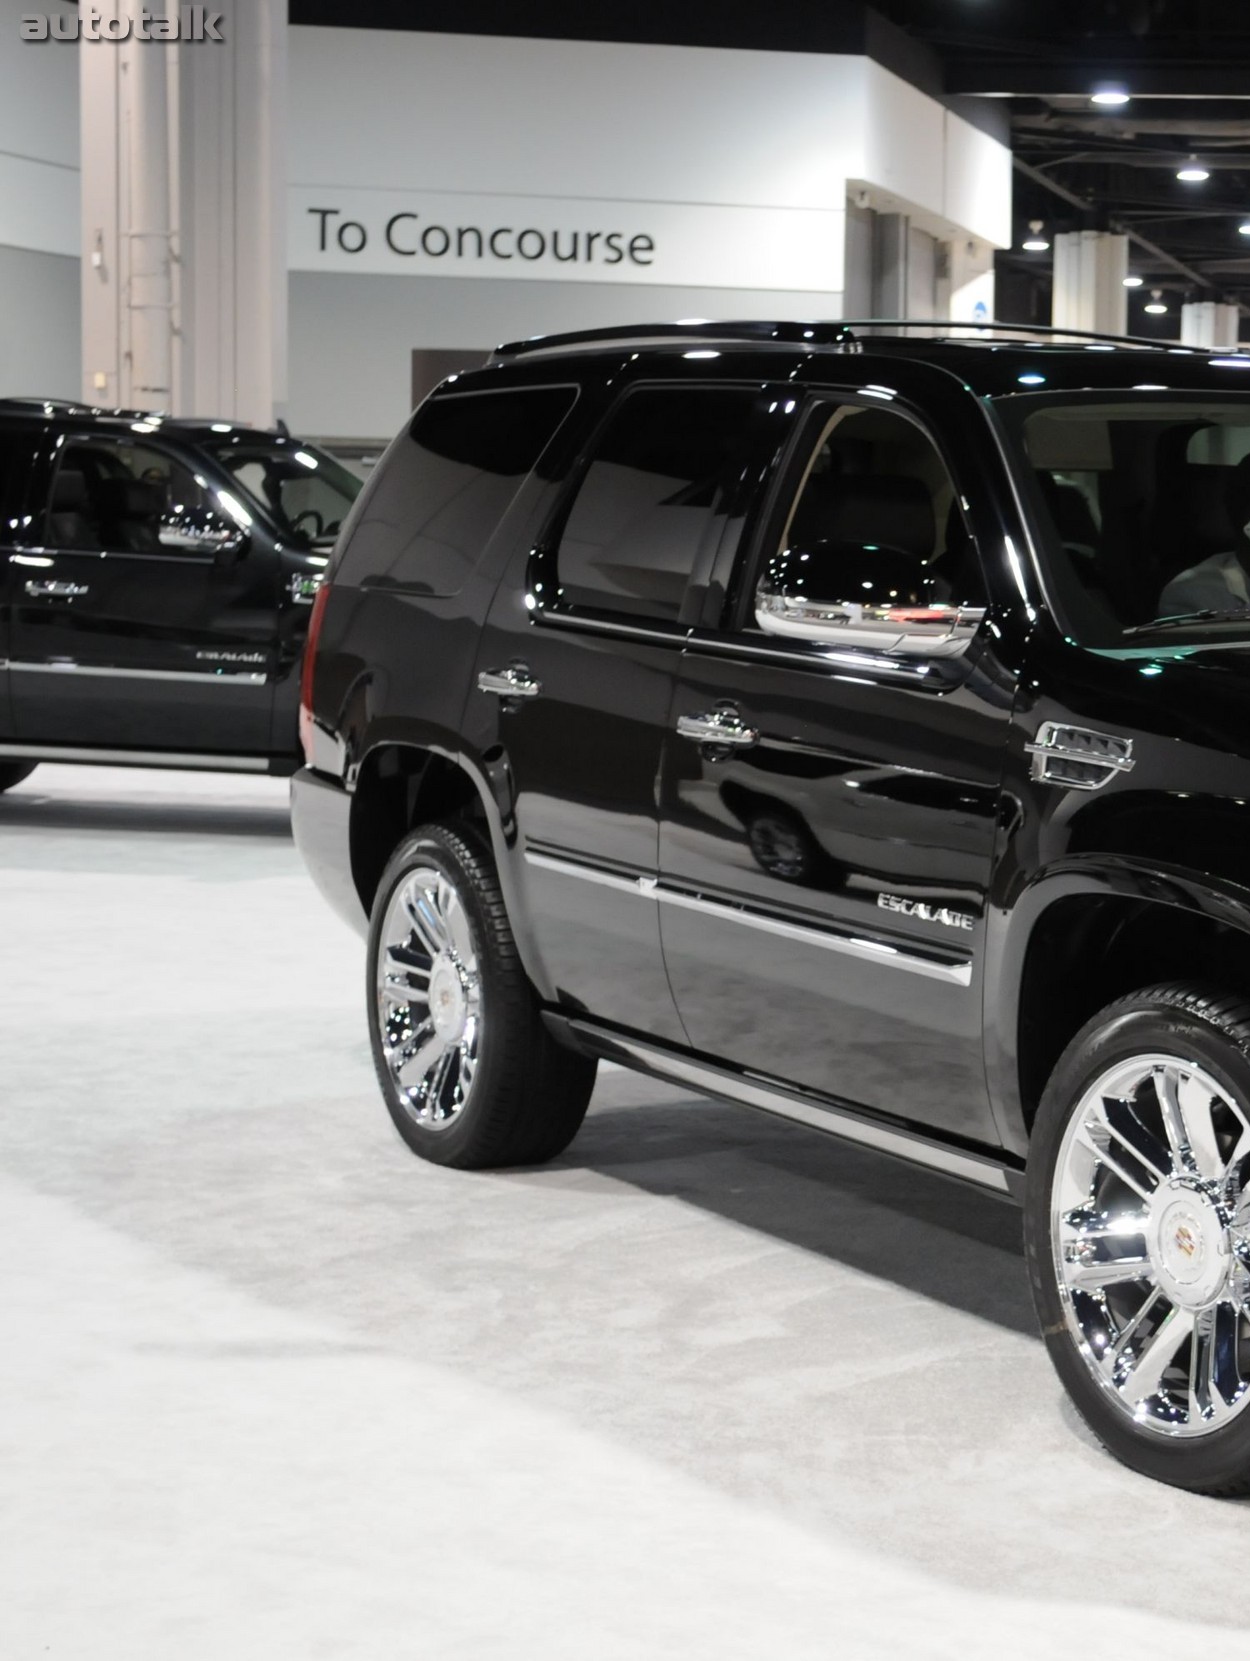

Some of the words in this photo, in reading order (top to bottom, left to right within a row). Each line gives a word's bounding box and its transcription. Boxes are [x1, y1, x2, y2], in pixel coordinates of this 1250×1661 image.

[307, 208, 368, 253] To
[385, 212, 656, 265] Concourse
[877, 892, 974, 931] ESCALADE
